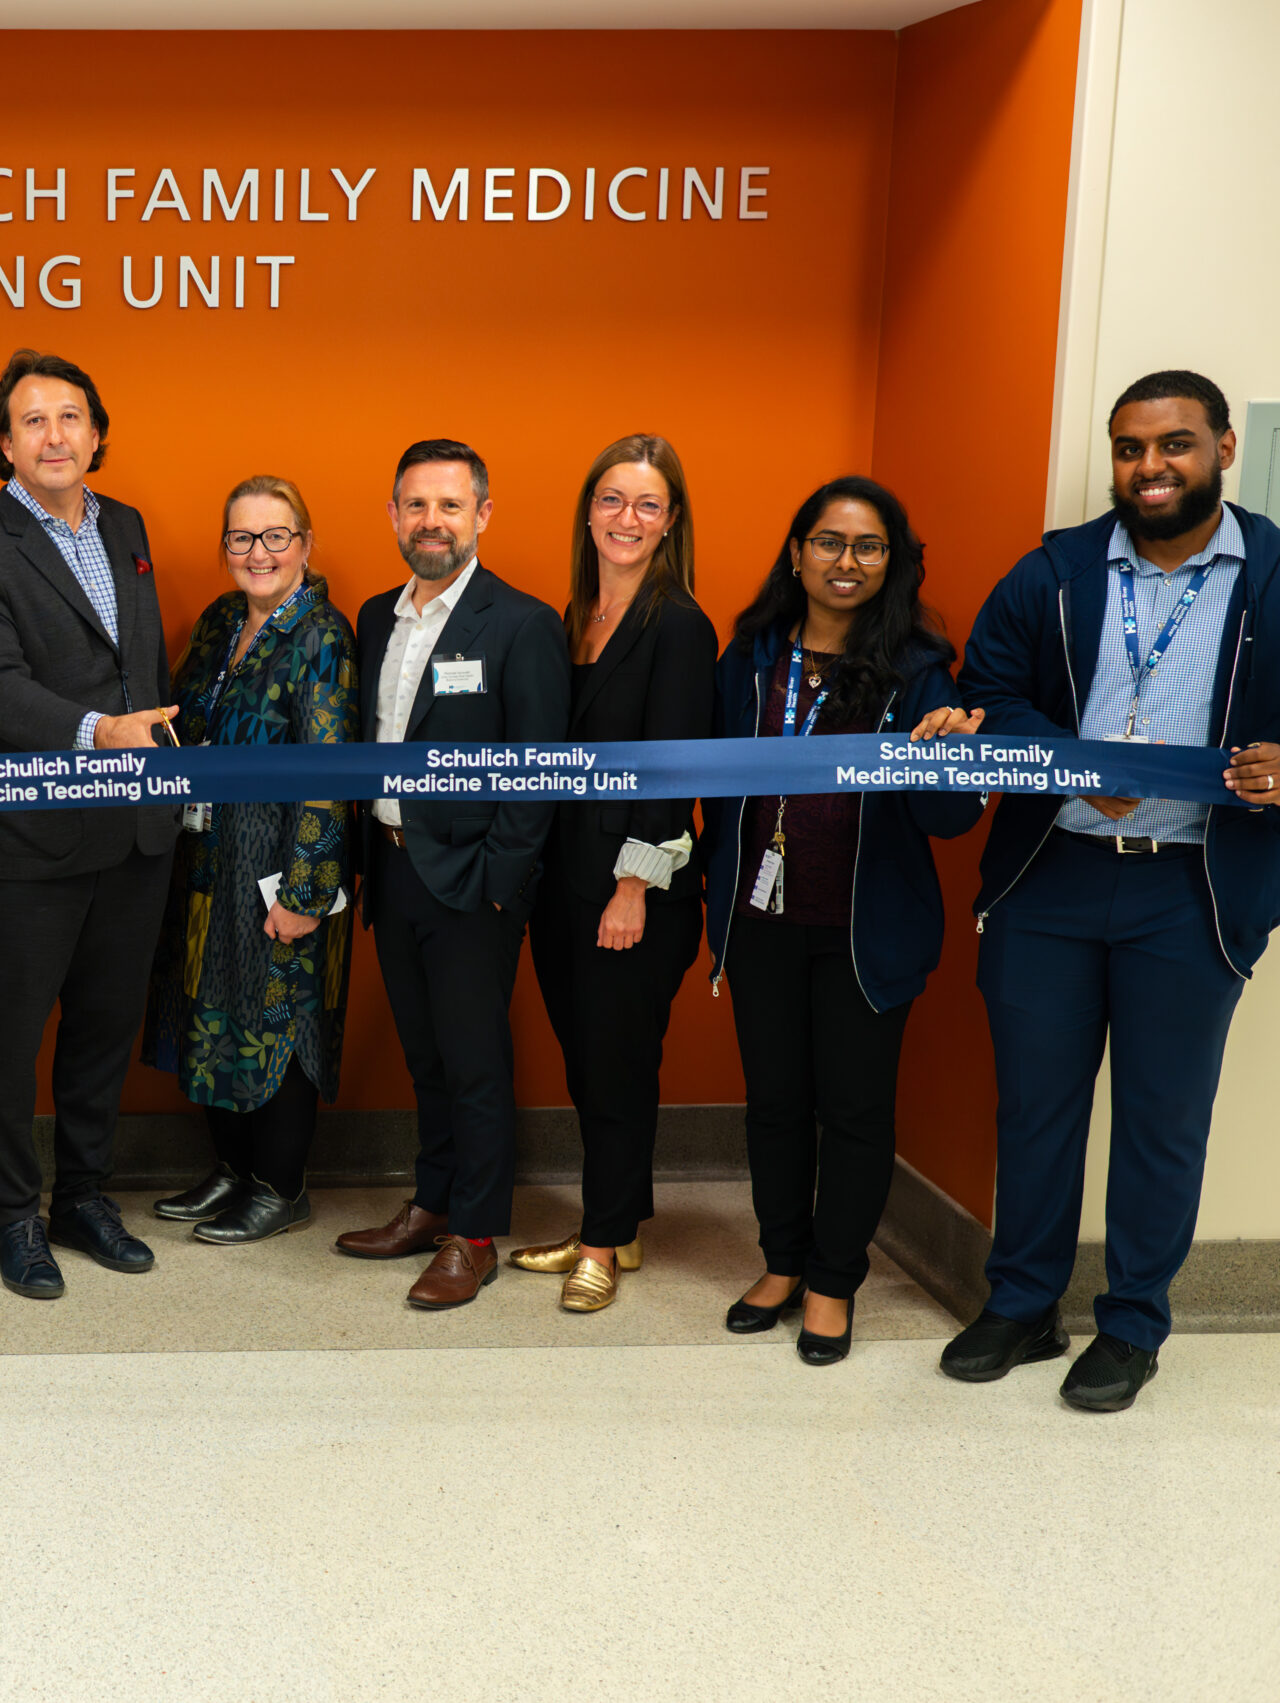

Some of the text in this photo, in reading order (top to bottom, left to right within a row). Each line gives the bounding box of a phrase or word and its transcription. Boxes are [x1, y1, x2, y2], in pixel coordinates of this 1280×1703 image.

[107, 168, 377, 222] FAMILY
[412, 167, 769, 222] MEDICINE
[124, 255, 295, 309] UNIT
[75, 753, 146, 776] Family
[426, 747, 596, 771] Schulich Family
[879, 742, 1054, 767] Schulich Family
[42, 778, 141, 801] Teaching
[147, 775, 191, 796] Unit
[383, 771, 638, 795] Medicine Teaching Unit
[836, 766, 1101, 791] Medicine Teaching Unit
